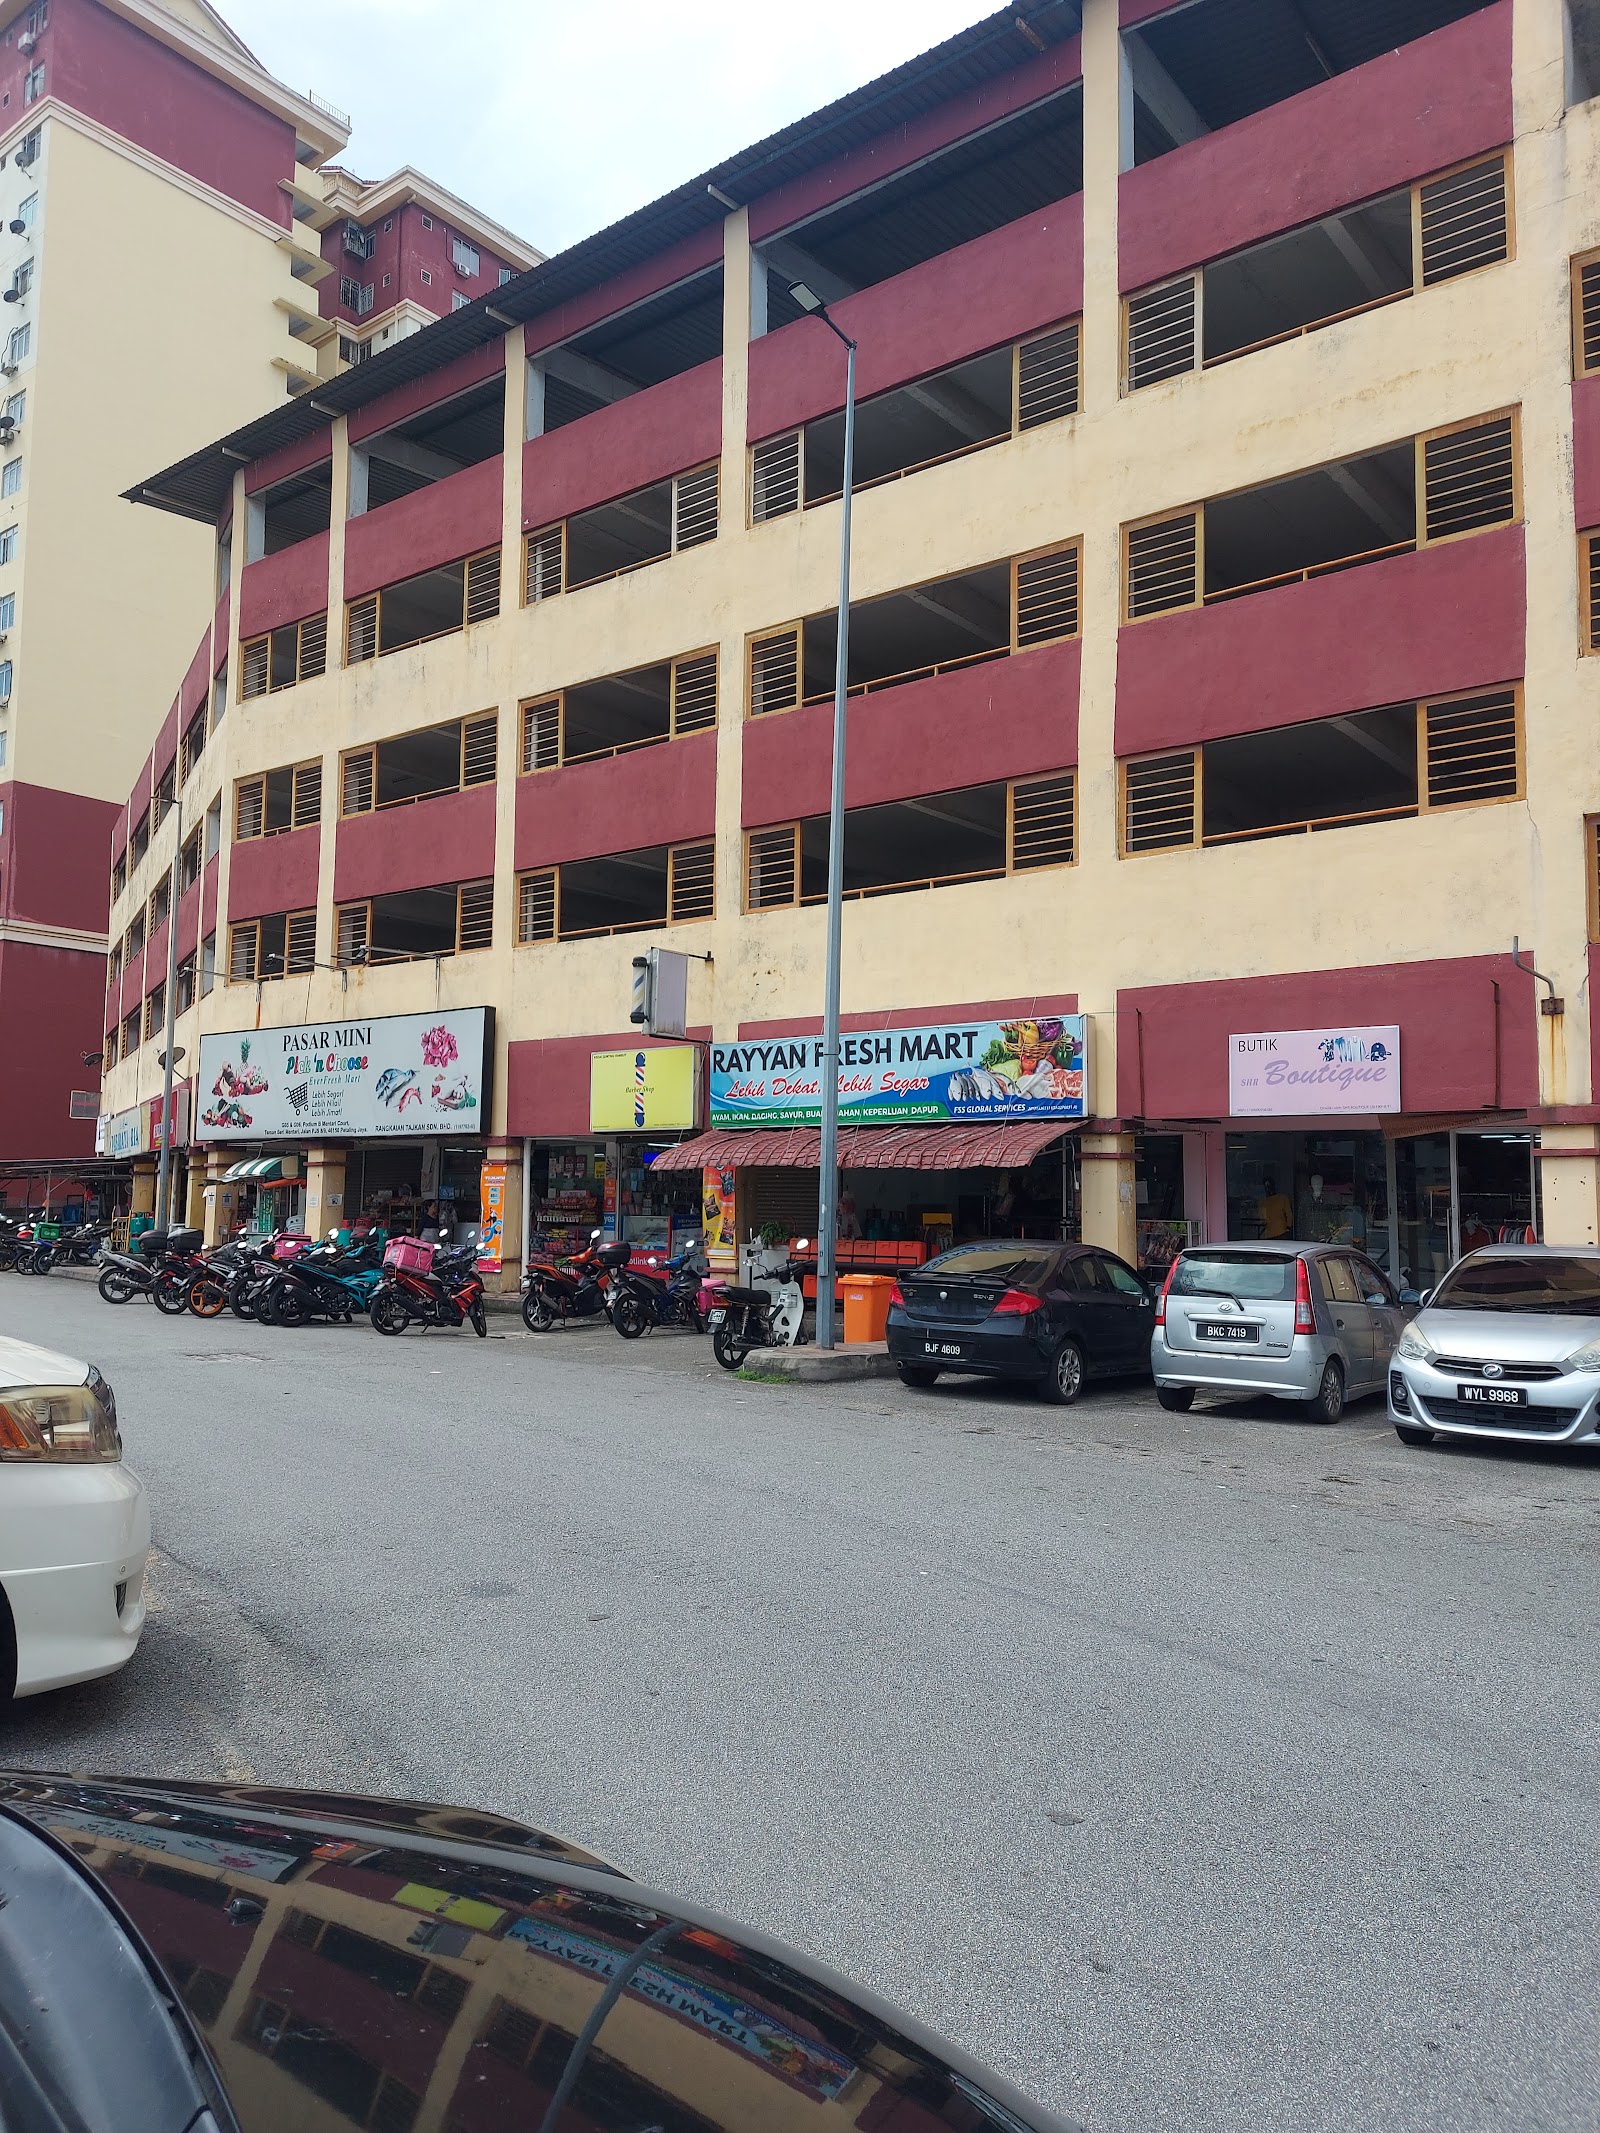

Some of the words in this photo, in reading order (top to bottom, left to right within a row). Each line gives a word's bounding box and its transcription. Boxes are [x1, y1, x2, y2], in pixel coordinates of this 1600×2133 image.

[282, 1031, 330, 1052] PASAR
[334, 1027, 372, 1048] MINI
[1238, 1038, 1278, 1052] BUTIK
[713, 1043, 806, 1073] RAYYAN
[900, 1031, 978, 1062] MART
[286, 1056, 311, 1074] Pick
[326, 1053, 368, 1072] Choose
[1264, 1060, 1388, 1092] Boutique
[642, 1086, 654, 1094] Shop
[726, 1080, 766, 1098] Lebih
[772, 1077, 821, 1096] Dekat,
[880, 1072, 929, 1096] Segar
[780, 1111, 804, 1119] SAYUR,
[863, 1107, 908, 1116] KEPERLUAN
[911, 1105, 938, 1114] DAPUR
[954, 1106, 966, 1114] FSS
[966, 1105, 993, 1113] GLOBAL
[994, 1104, 1026, 1113] SERVICES
[604, 1216, 614, 1224] yes
[627, 1257, 648, 1265] otlink
[1207, 1326, 1224, 1336] BKC
[1227, 1327, 1246, 1338] 7419
[925, 1343, 939, 1353] BJF
[941, 1344, 960, 1355] 4609
[1464, 1387, 1487, 1400] WYL
[1489, 1389, 1518, 1403] 9968
